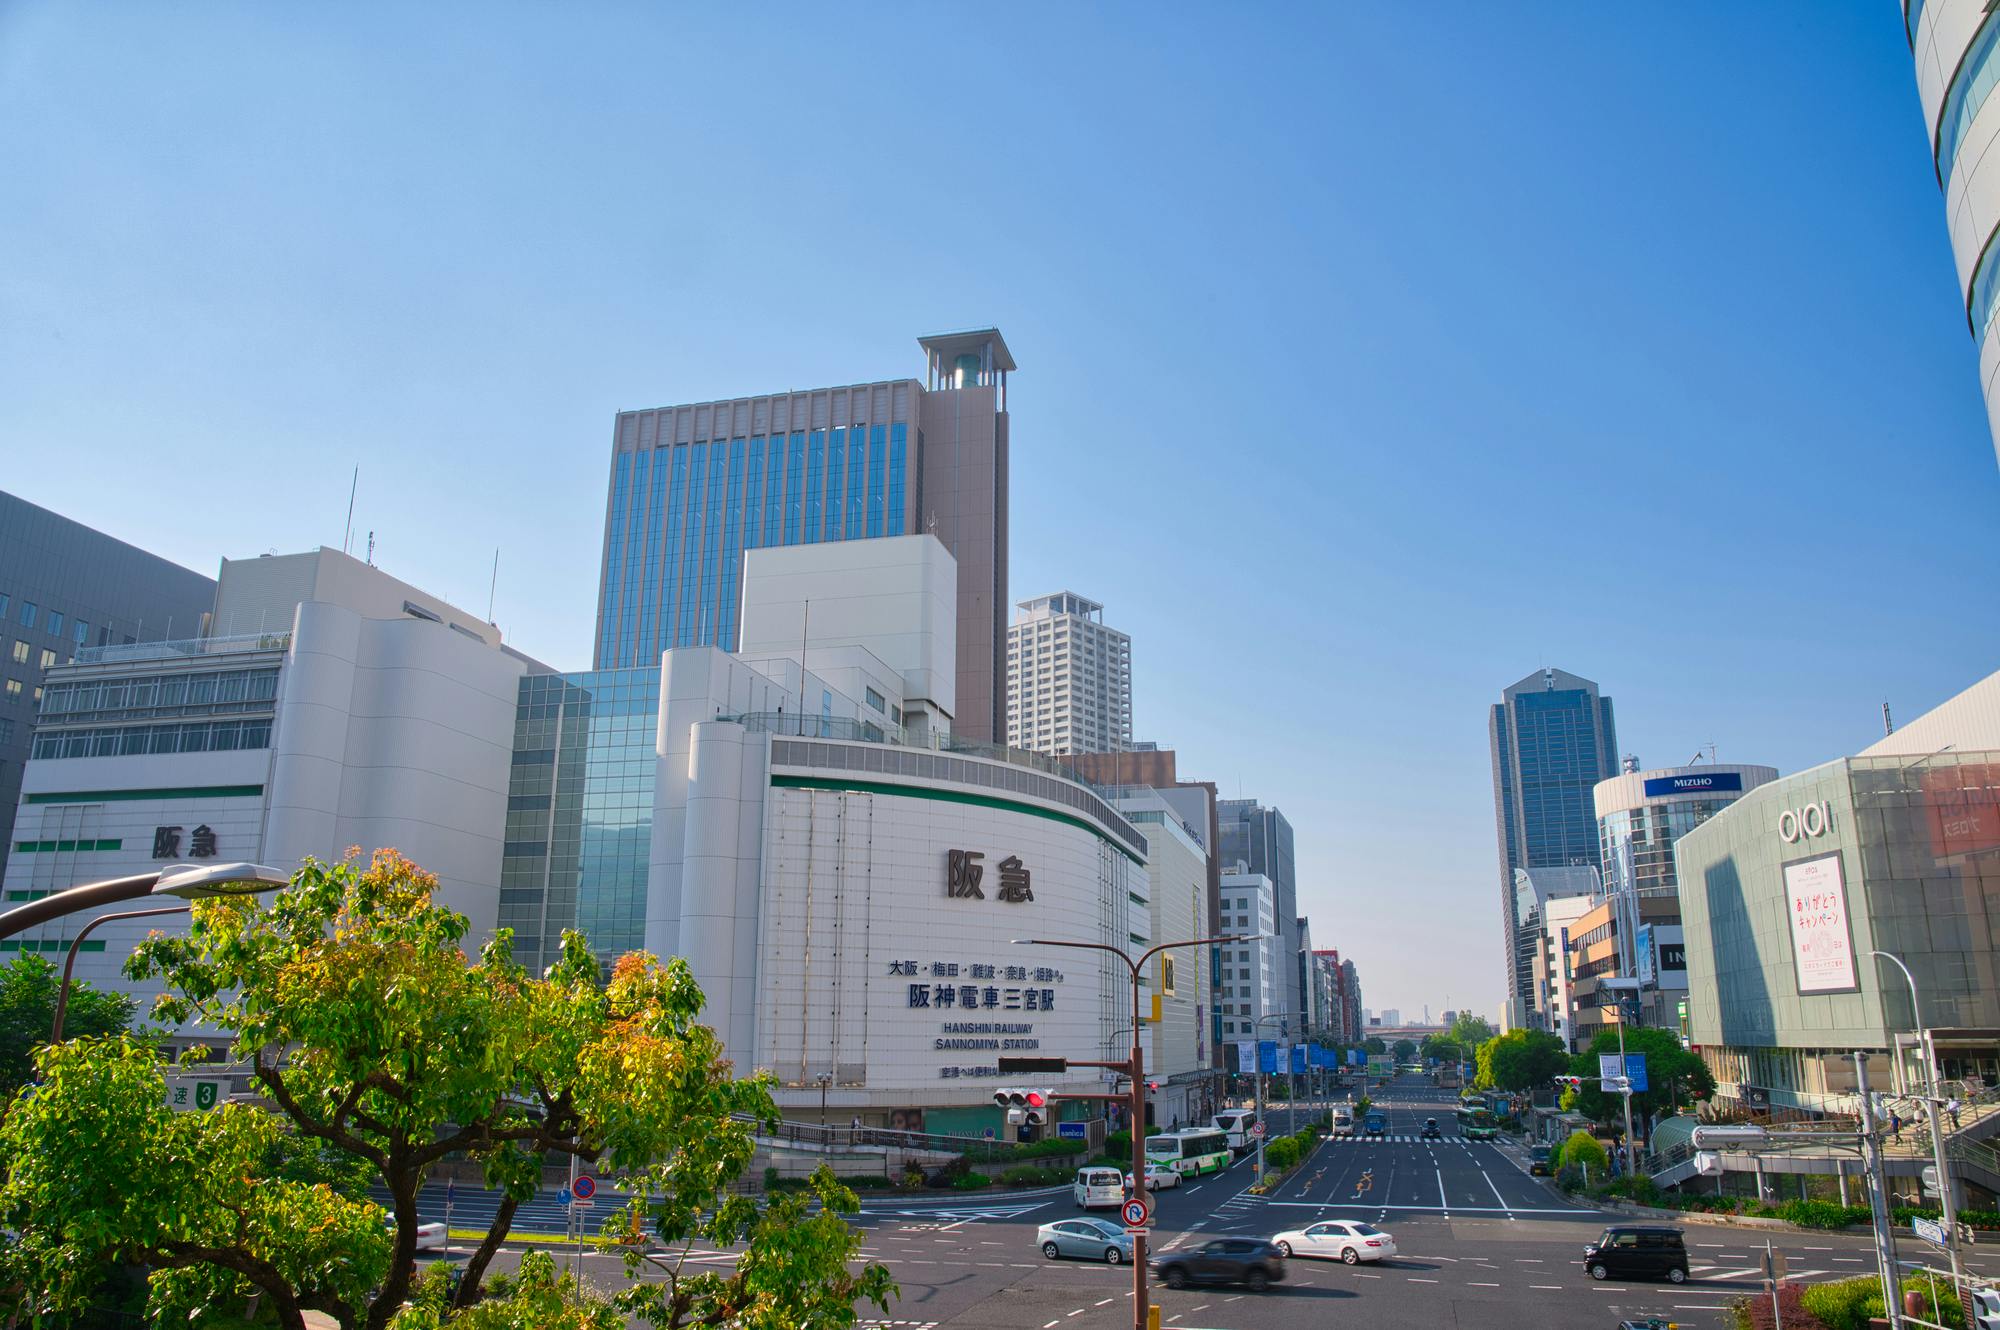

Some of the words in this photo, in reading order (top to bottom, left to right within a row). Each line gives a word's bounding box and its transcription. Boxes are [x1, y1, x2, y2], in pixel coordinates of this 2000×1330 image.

[1674, 777, 1712, 787] MIZUHO
[152, 824, 217, 859] 阪急
[948, 849, 1034, 902] 阪急
[1798, 912, 1839, 929] キャンペーン
[908, 984, 1055, 1010] 阪神電車三宮駅
[944, 1022, 992, 1034] HANSHIN
[994, 1023, 1034, 1034] RAILWAY
[935, 1038, 1000, 1050] SANNOMIYA
[1002, 1038, 1039, 1050] STATION
[201, 1086, 211, 1104] 3
